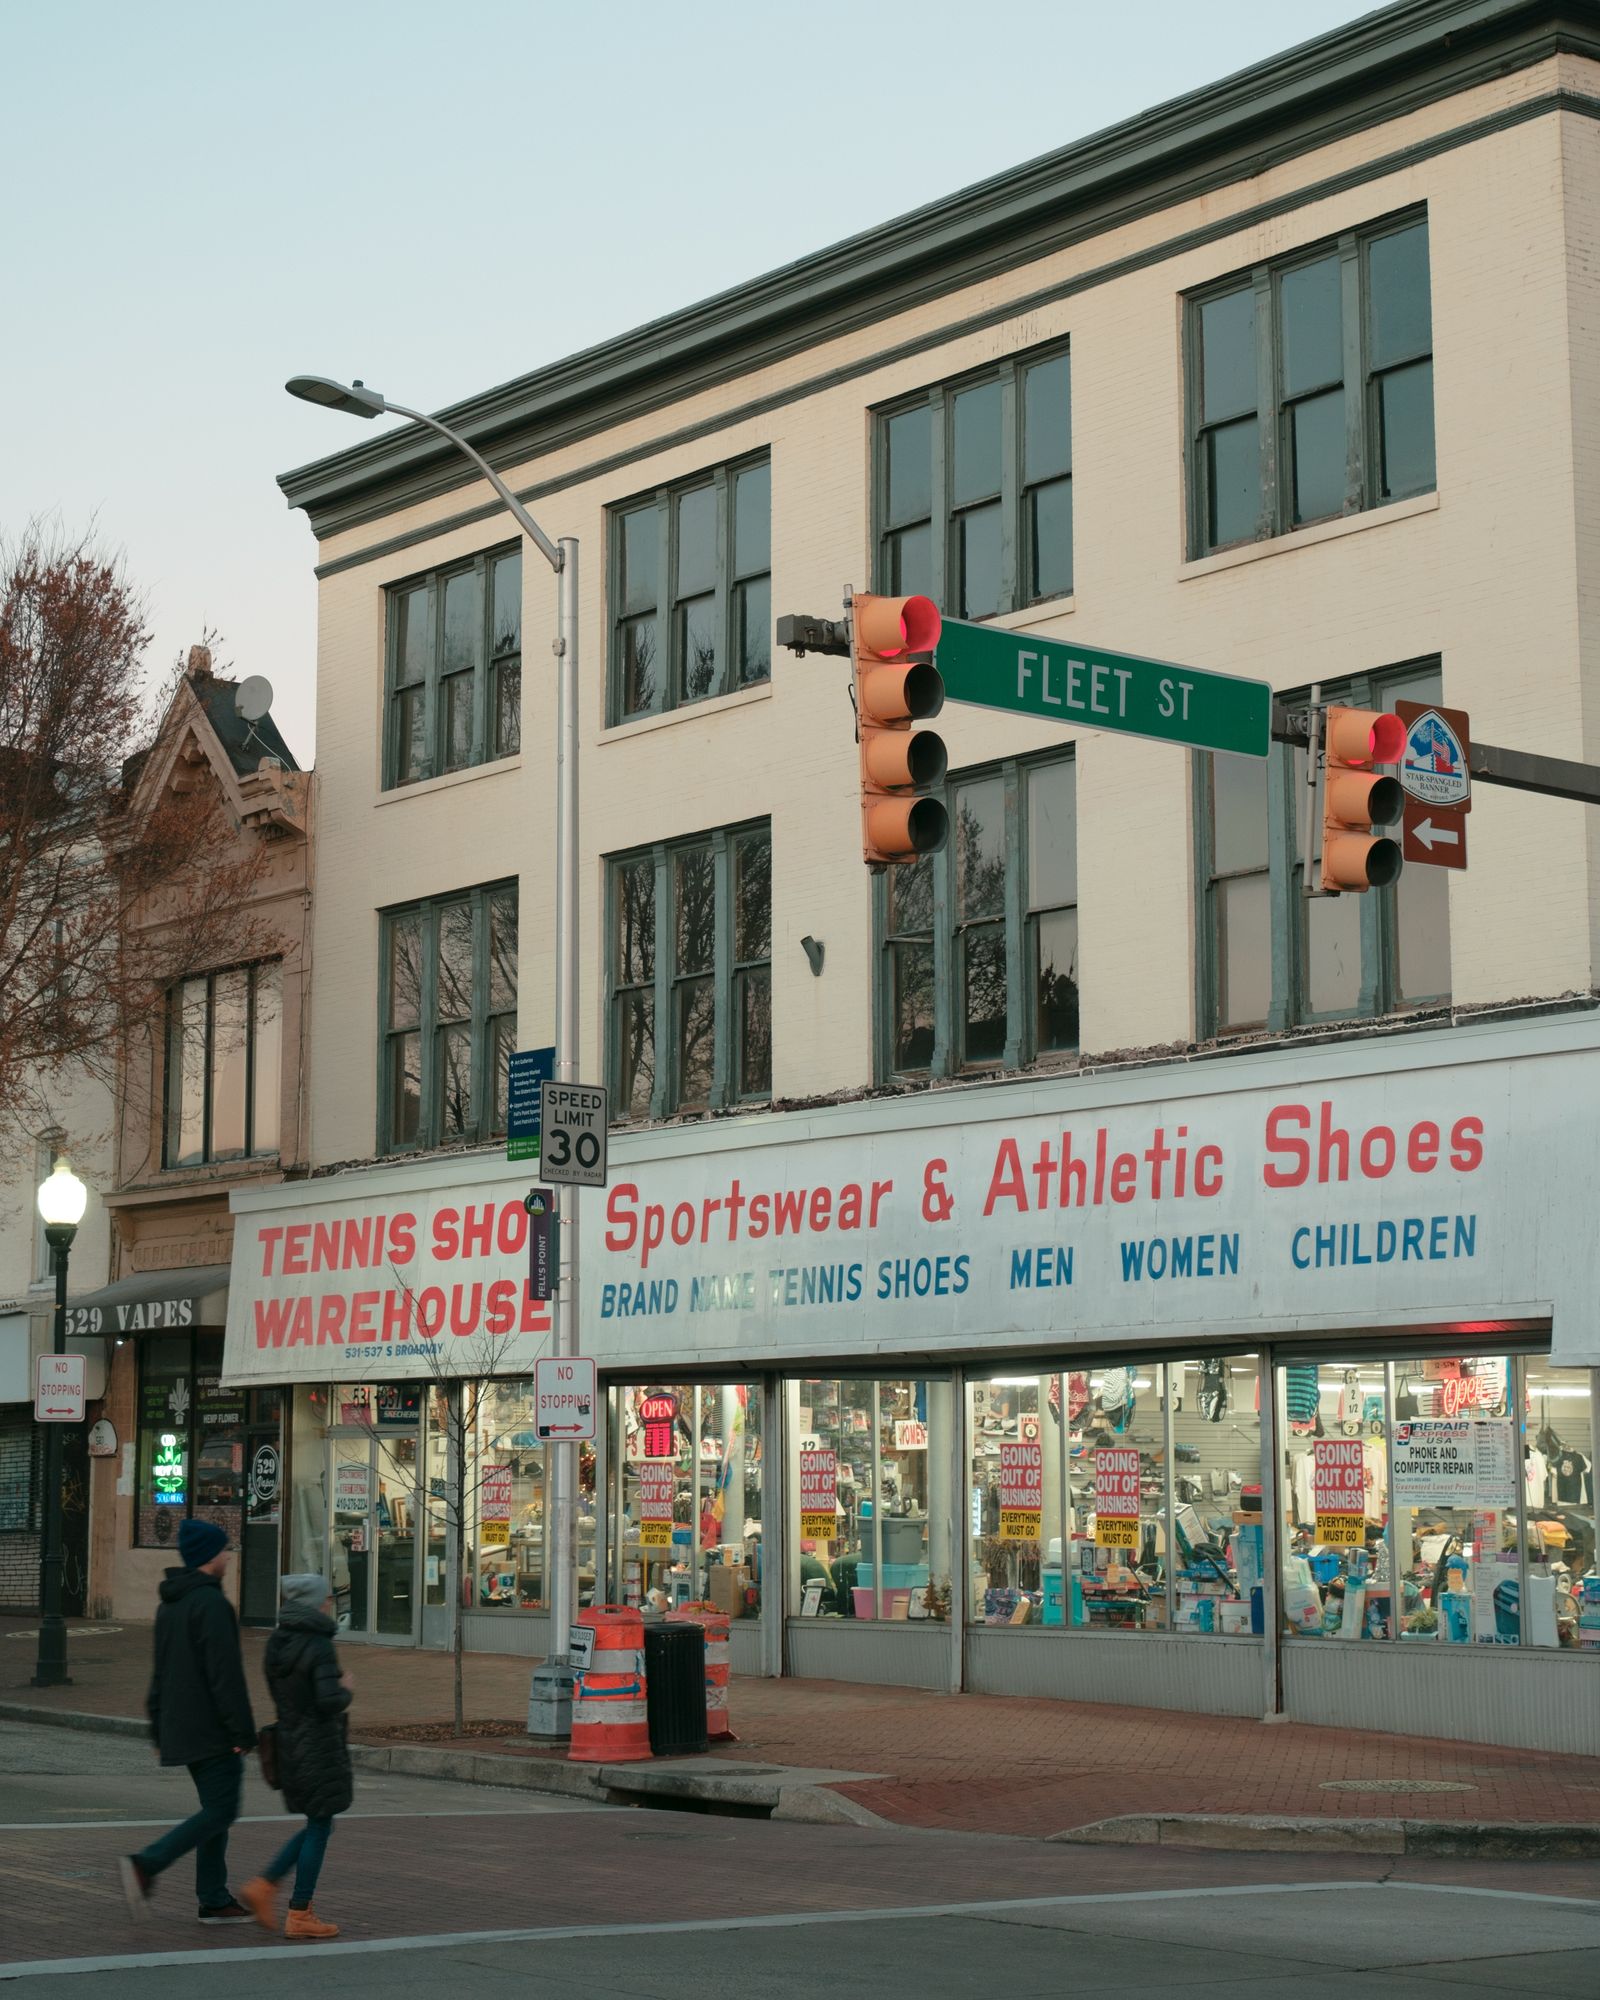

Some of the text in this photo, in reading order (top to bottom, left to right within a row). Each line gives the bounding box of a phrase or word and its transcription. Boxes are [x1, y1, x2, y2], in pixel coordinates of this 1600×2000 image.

[1017, 650, 1194, 720] FLEET ST
[1406, 773, 1462, 788] STAR-SPANGLED
[1420, 782, 1450, 794] BANNER
[548, 1090, 602, 1109] SPEED
[554, 1109, 595, 1127] LIMIT
[547, 1129, 600, 1169] 30
[543, 1167, 570, 1177] CHECKED
[584, 1170, 602, 1179] RADAR
[605, 1100, 1484, 1269] Sportswear & Athletic Shoes
[257, 1199, 534, 1277] TENNIS SHO
[538, 1234, 547, 1298] FELL'S POINT
[600, 1214, 1477, 1319] BRAND NAME TENNIS SHOES MEN WOMEN CHILDREN
[65, 1299, 193, 1336] 529 VAPES
[254, 1278, 552, 1349] WAREHOUSE
[345, 1342, 444, 1360] 531-537 S BROADWAY
[55, 1362, 68, 1374] NO
[557, 1366, 574, 1381] NO
[41, 1384, 81, 1396] STOPPING
[1442, 1378, 1489, 1417] Open
[540, 1393, 591, 1410] STOPPING
[642, 1399, 673, 1418] OPEN
[218, 1413, 239, 1424] FLOWER
[383, 1410, 420, 1419] SKECHERS
[1412, 1430, 1468, 1438] EXPRESS
[1413, 1422, 1470, 1431] REPAIR
[1426, 1437, 1453, 1445] USA
[1001, 1446, 1041, 1466] GOING
[1315, 1443, 1363, 1466] GOING
[1410, 1446, 1458, 1459] PHONE AND
[257, 1458, 275, 1474] 529
[801, 1453, 835, 1472] GOING
[1096, 1452, 1138, 1473] GOING
[1394, 1461, 1474, 1475] COMPUTER REPAIR
[481, 1467, 512, 1485] GOING
[640, 1465, 672, 1483] GOING
[801, 1474, 835, 1490] OUT OF
[1001, 1468, 1041, 1487] OUT OF
[1316, 1468, 1363, 1488] OUT OF
[641, 1484, 672, 1499] OUT OF
[1096, 1474, 1138, 1493] OUT OF
[482, 1487, 512, 1501] OUT OF
[801, 1492, 835, 1510] BUSINESS
[1001, 1488, 1041, 1507] BUSINESS
[1316, 1490, 1363, 1510] BUSINESS
[481, 1504, 511, 1518] BUSINESS
[640, 1502, 672, 1518] BUSINESS
[1096, 1495, 1139, 1514] BUSINESS
[801, 1515, 836, 1526] EVERYTHING
[1001, 1512, 1041, 1524] EVERYTHING
[1096, 1519, 1139, 1532] EVERYTHING
[1317, 1516, 1364, 1530] EVERYTHING
[481, 1522, 510, 1532] EVERYTHING
[641, 1523, 672, 1533] EVERYTHING
[806, 1527, 831, 1537] MUST GO
[1006, 1525, 1035, 1537] MUST GO
[485, 1533, 505, 1542] MUST GO
[644, 1535, 667, 1544] MUST GO
[1102, 1532, 1133, 1545] MUST GO
[1323, 1529, 1357, 1543] MUST GO
